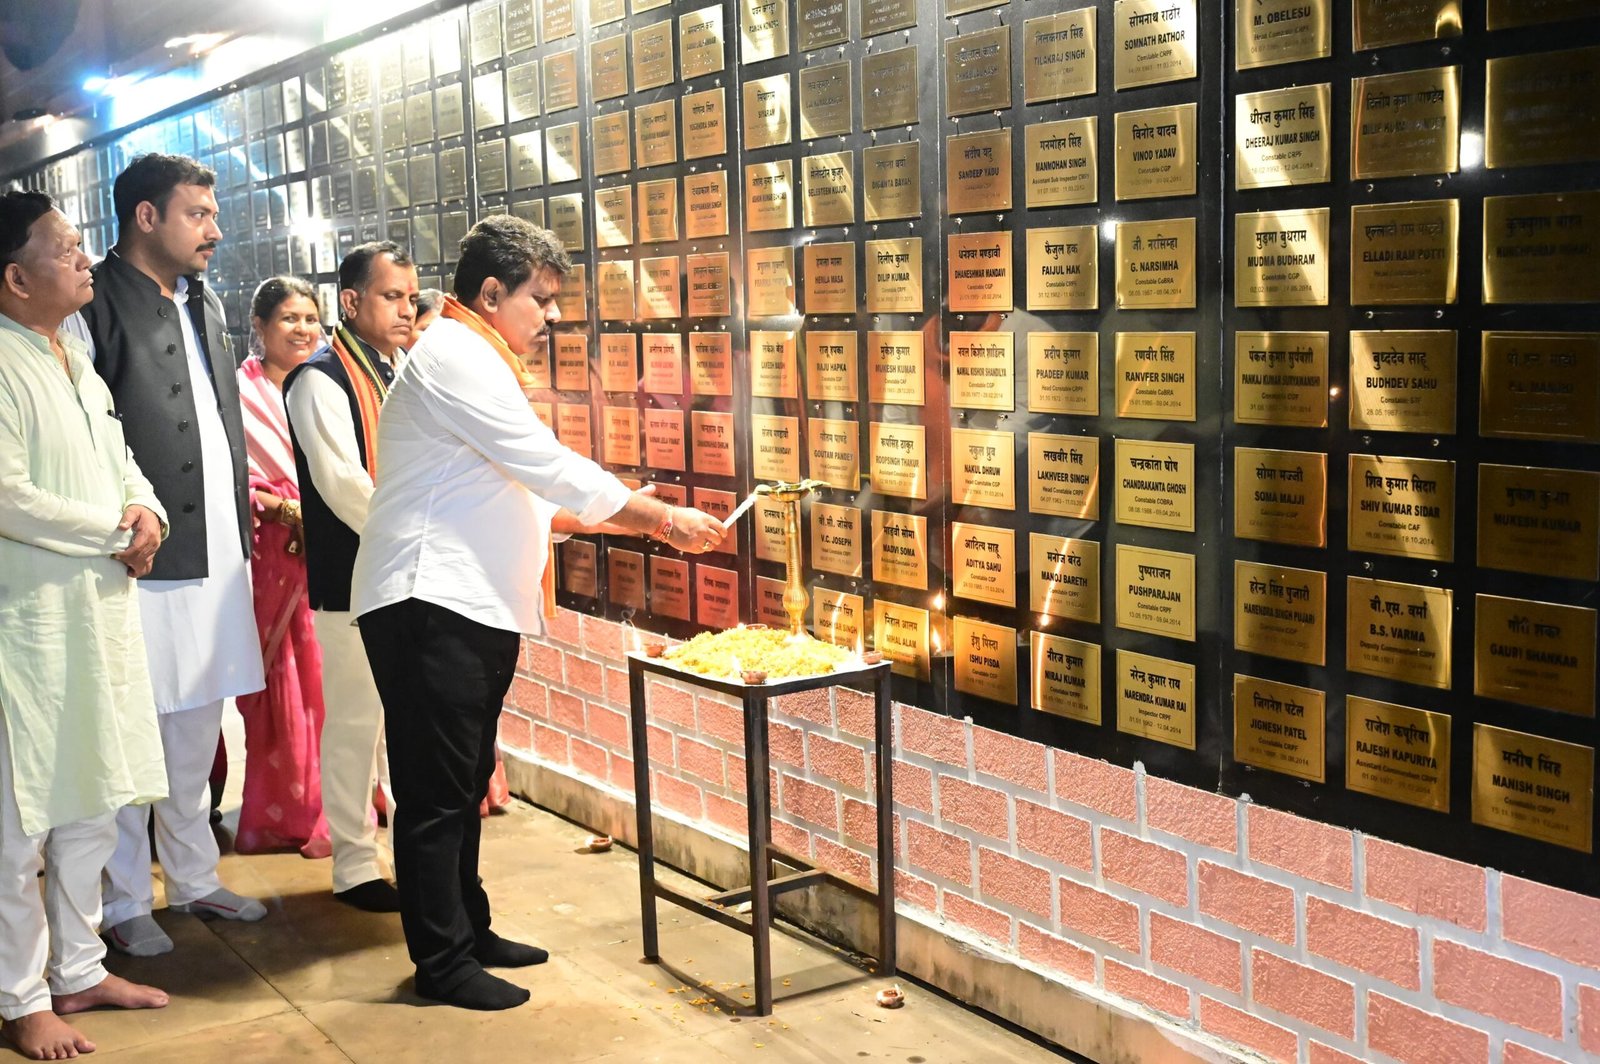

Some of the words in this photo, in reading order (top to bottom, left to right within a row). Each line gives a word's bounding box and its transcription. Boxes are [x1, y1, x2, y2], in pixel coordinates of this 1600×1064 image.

[1129, 11, 1158, 27] सोमनाथ
[1070, 24, 1084, 40] सिंह
[1124, 34, 1157, 50] SOMNATH
[1158, 30, 1185, 44] RATHOR
[1065, 50, 1085, 61] SINGH
[1250, 108, 1271, 125] धीरज
[1274, 106, 1297, 128] कुमार
[1298, 101, 1315, 120] सिंह
[1132, 124, 1154, 140] विनोद
[1157, 124, 1177, 137] यादव
[1245, 136, 1274, 149] DHEERAJ
[1275, 134, 1298, 145] KUMAR
[1299, 130, 1320, 143] SINGH
[1133, 150, 1152, 161] VINOD
[1154, 148, 1176, 159] YADAV
[1036, 159, 1067, 172] MANMOHAN
[1068, 157, 1086, 168] SINGH
[959, 169, 982, 180] SANDEEP
[1148, 233, 1177, 250] नरसिम्हा
[1045, 240, 1064, 261] फैजुल
[1363, 251, 1396, 263] ELLADI
[895, 253, 909, 267] कुमार
[1130, 263, 1138, 272] G.
[1140, 260, 1179, 272] NARSIMHA
[1247, 257, 1274, 268] MUDMA
[1277, 254, 1315, 266] BUDHRAM
[878, 273, 891, 283] DILIP
[892, 272, 909, 282] KUMAR
[1042, 265, 1064, 275] FAIJUL
[1066, 264, 1081, 274] HAK
[1135, 278, 1157, 286] Constable
[896, 345, 910, 360] कुमार
[1044, 345, 1060, 361] प्रदीप
[1062, 348, 1080, 364] कुमार
[1135, 346, 1157, 362] रणवीर
[1160, 345, 1175, 362] सिंह
[830, 363, 846, 373] HAPKA
[875, 364, 896, 374] MUKESH
[897, 364, 916, 375] KUMAR
[1036, 369, 1064, 379] PRADEEP
[1066, 370, 1088, 381] KUMAR
[1161, 372, 1185, 383] SINGH
[1366, 377, 1408, 389] BUDHDEV
[1411, 378, 1437, 390] SAHU
[901, 457, 919, 468] THAKUR
[1043, 448, 1068, 464] लखवीर
[1070, 449, 1083, 465] सिंह
[1164, 456, 1178, 473] घोष
[964, 464, 981, 475] NAKUL
[1038, 470, 1069, 483] LAKHVEER
[1070, 473, 1089, 485] SINGH
[1123, 478, 1165, 493] CHANDRAKANTA
[1166, 483, 1186, 495] GHOSH
[1365, 470, 1382, 490] शिव
[1385, 474, 1408, 496] कुमार
[1255, 491, 1277, 503] SOMA
[1279, 493, 1305, 506] MAJJI
[1361, 500, 1379, 512] SHIV
[1381, 502, 1411, 516] KUMAR
[1413, 506, 1440, 519] SIDAR
[1542, 516, 1581, 533] KUMAR
[821, 535, 831, 545] V.C.
[832, 536, 852, 547] JOSEPH
[965, 536, 986, 552] आदित्य
[900, 547, 915, 557] SOMA
[966, 558, 985, 570] ADITYA
[986, 562, 1001, 573] SAHU
[1138, 565, 1171, 581] पुष्पराजन
[1041, 571, 1062, 583] MANOJ
[1063, 575, 1087, 587] BARETH
[1129, 585, 1181, 602] PUSHPARAJAN
[1137, 602, 1159, 612] Constable
[1370, 623, 1388, 637] B.S.
[1391, 627, 1426, 642] VARMA
[902, 639, 917, 650] ALAM
[1490, 643, 1522, 659] GAURI
[970, 654, 982, 665] ISHU
[984, 658, 1000, 671] PISDA
[1047, 648, 1063, 665] नीरज
[1066, 654, 1083, 670] कुमार
[1045, 670, 1063, 684] NIRAJ
[1064, 676, 1085, 690] KUMAR
[1148, 672, 1166, 689] कुमार
[1169, 677, 1181, 690] राय
[1124, 689, 1154, 703] NARENDRA
[1155, 695, 1175, 709] KUMAR
[1176, 702, 1186, 713] RAI
[1250, 718, 1282, 735] JIGNESH
[1284, 727, 1307, 741] PATEL
[1356, 741, 1390, 758] RAJESH
[1392, 748, 1437, 769] KAPURIYA
[1502, 749, 1533, 769] मनीष
[1538, 753, 1562, 777] सिंह
[1492, 774, 1533, 795] MANISH
[1536, 783, 1570, 803] SINGH
